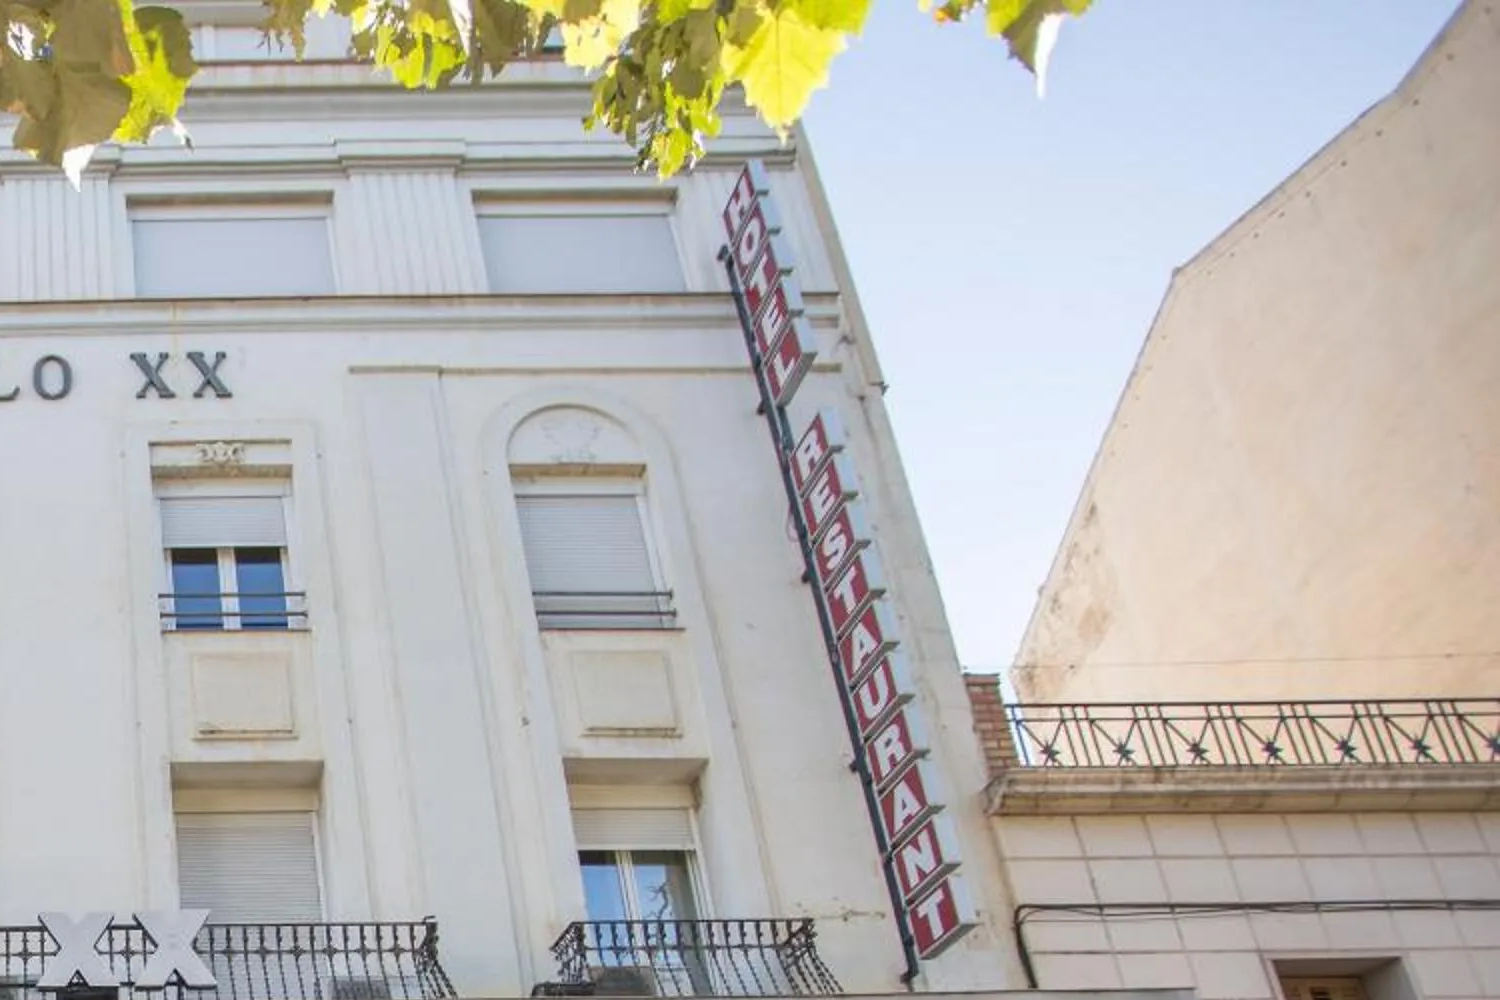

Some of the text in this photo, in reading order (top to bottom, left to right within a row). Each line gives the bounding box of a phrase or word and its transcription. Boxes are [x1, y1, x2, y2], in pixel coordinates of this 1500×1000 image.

[727, 170, 799, 391] HOTEL
[129, 351, 234, 401] XX
[801, 428, 949, 942] RESTAURANT
[36, 909, 219, 991] XX
